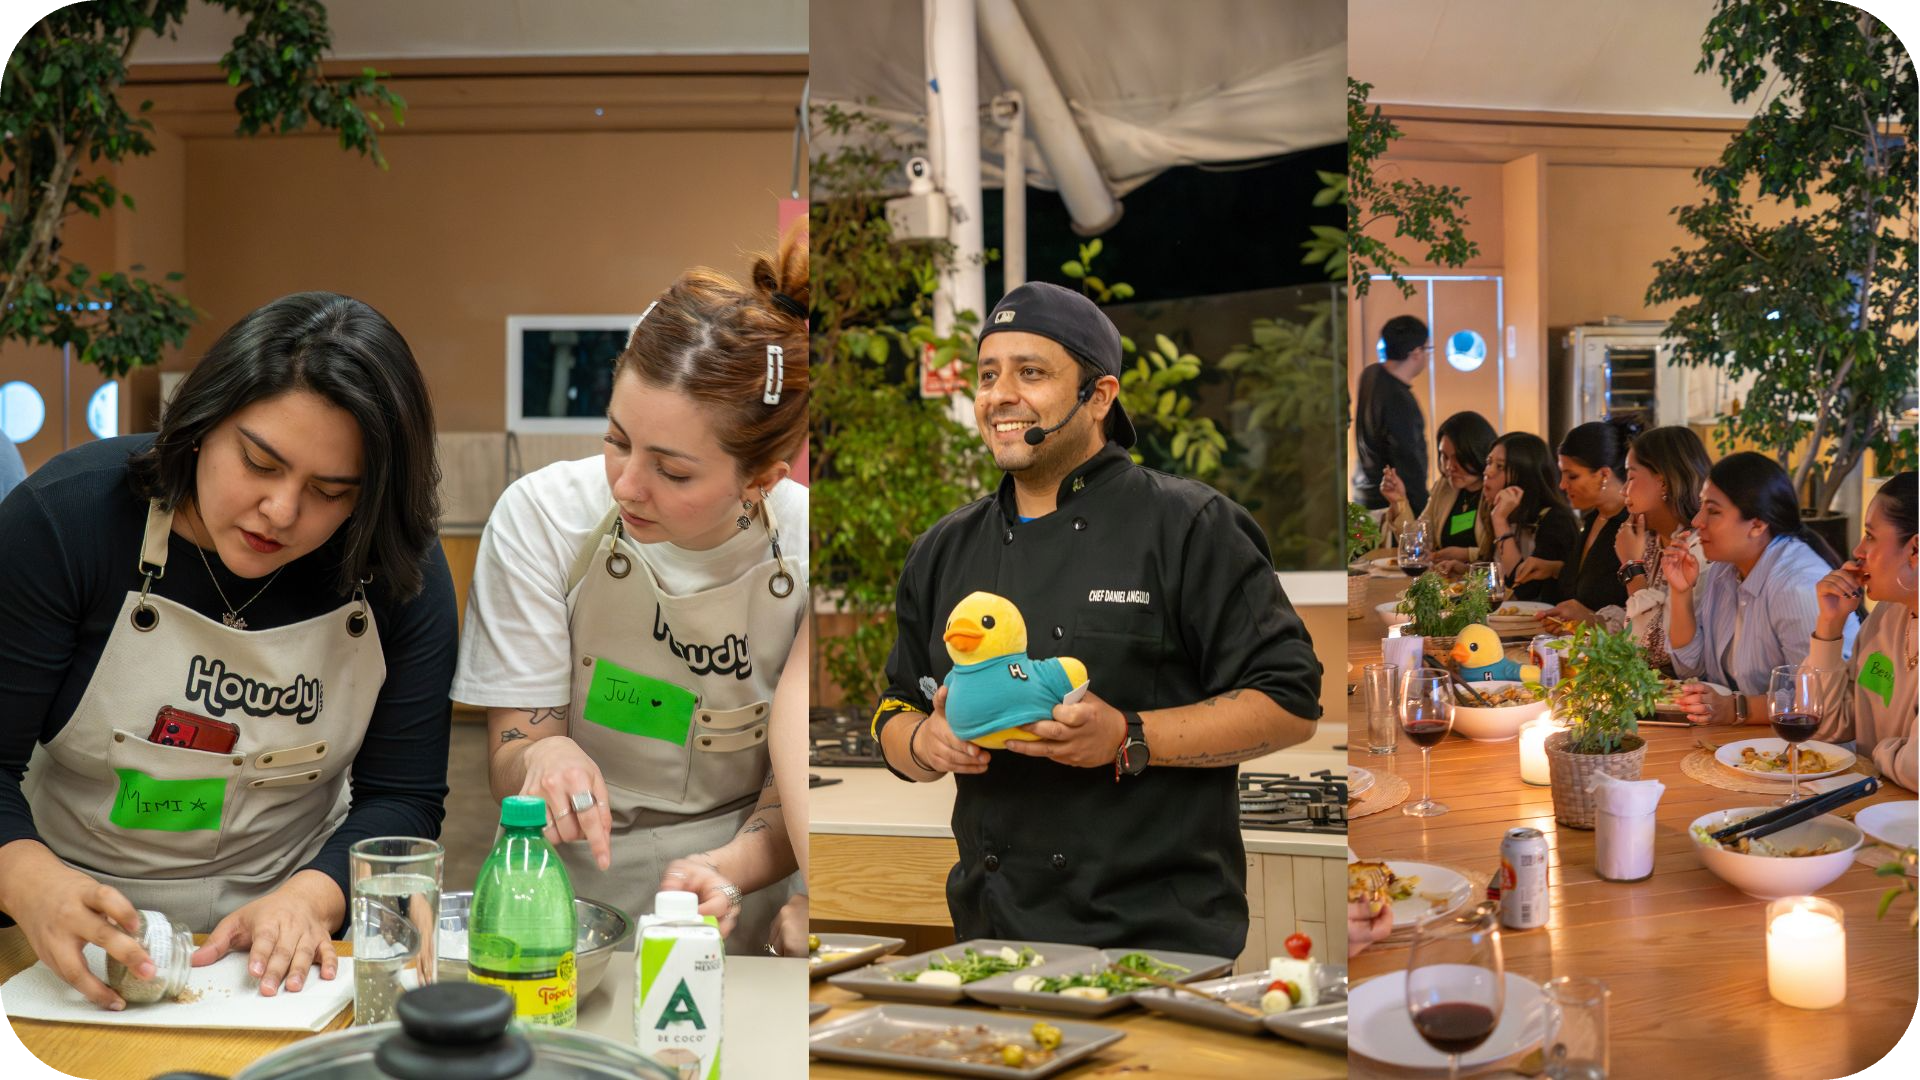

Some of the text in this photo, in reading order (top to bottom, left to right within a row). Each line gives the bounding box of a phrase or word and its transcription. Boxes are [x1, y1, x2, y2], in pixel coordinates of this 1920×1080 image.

[1088, 589, 1150, 605] CHEF DANIEL ANGULO
[185, 655, 320, 725] Howdy
[538, 985, 568, 1006] Topo
[654, 976, 707, 1030] A
[658, 1034, 669, 1043] DE
